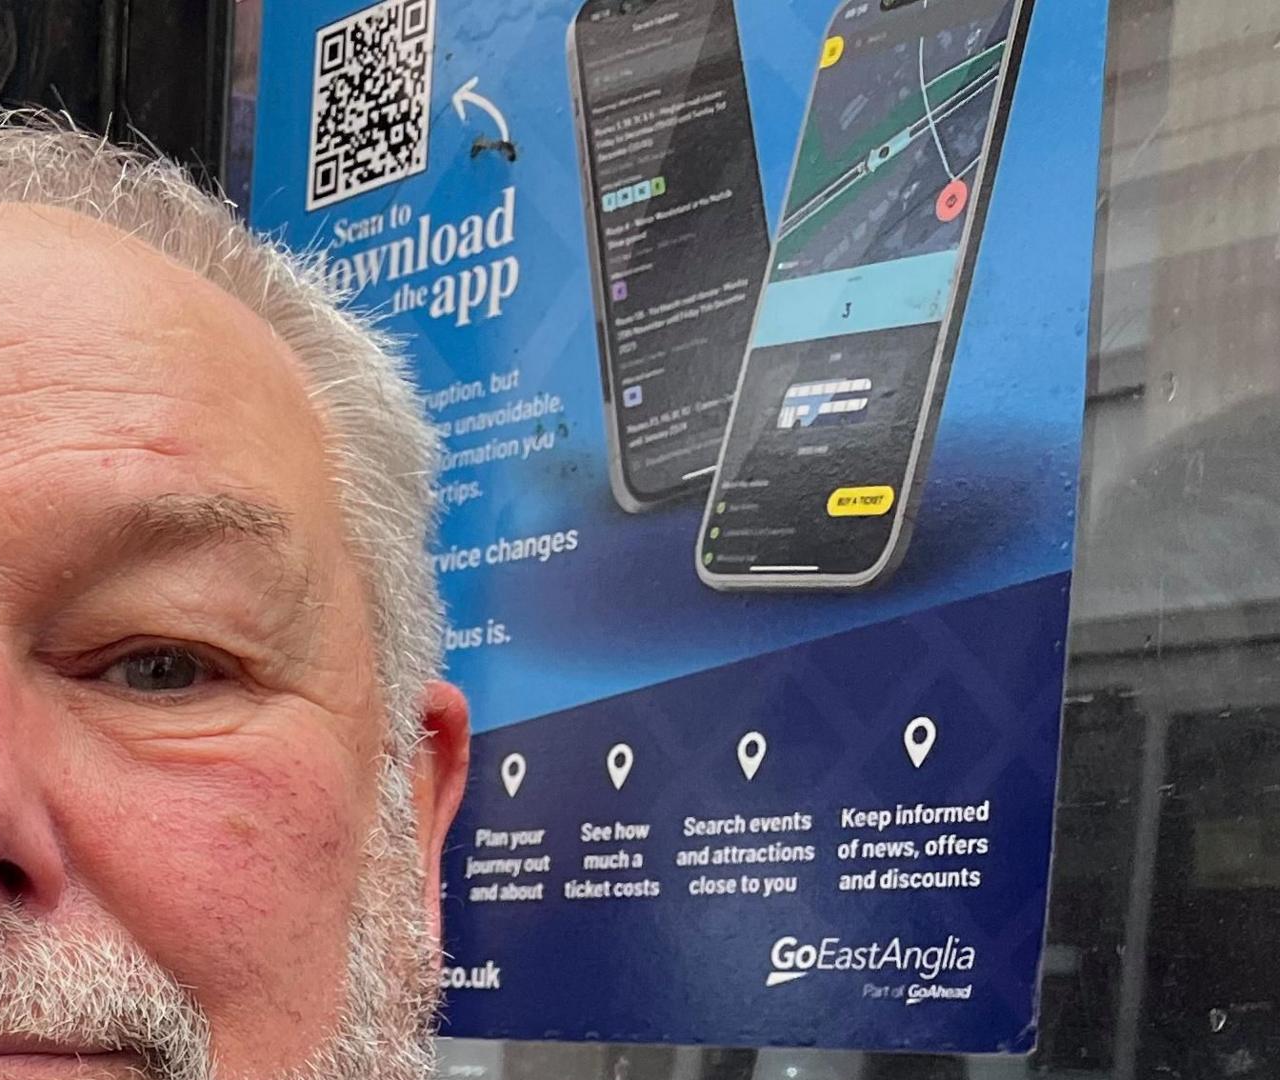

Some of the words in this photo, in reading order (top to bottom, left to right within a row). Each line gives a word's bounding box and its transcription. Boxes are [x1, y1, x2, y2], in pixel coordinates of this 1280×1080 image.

[334, 213, 384, 247] Scan
[391, 203, 412, 228] to
[392, 283, 428, 313] the
[429, 256, 520, 327] app
[490, 369, 520, 393] but
[454, 393, 564, 435] unavoidable.
[522, 431, 555, 460] you
[485, 529, 579, 562] changes
[445, 625, 483, 650] bus
[487, 618, 511, 644] is.
[683, 814, 746, 837] Search
[749, 811, 812, 833] events
[841, 807, 892, 832] Keep
[895, 800, 990, 826] informed
[475, 828, 508, 848] Plan
[511, 829, 546, 850] your
[580, 822, 611, 843] See
[614, 821, 651, 841] how
[583, 849, 629, 870] much
[631, 854, 643, 868] a
[676, 846, 710, 866] and
[712, 841, 816, 865] attractions
[837, 838, 860, 860] of
[861, 840, 920, 862] news,
[924, 834, 989, 856] offers
[464, 856, 522, 879] journey
[524, 855, 551, 872] out
[839, 869, 877, 891] and
[879, 868, 981, 890] discounts
[469, 883, 499, 902] and
[500, 882, 544, 901] about
[563, 880, 610, 899] ticket
[613, 879, 660, 897] costs
[689, 874, 737, 896] close
[740, 875, 760, 893] to
[763, 876, 797, 898] you
[770, 935, 975, 980] GoEastAnglia
[862, 983, 889, 998] Part
[892, 983, 906, 998] of
[907, 983, 973, 1000] GoAhead
